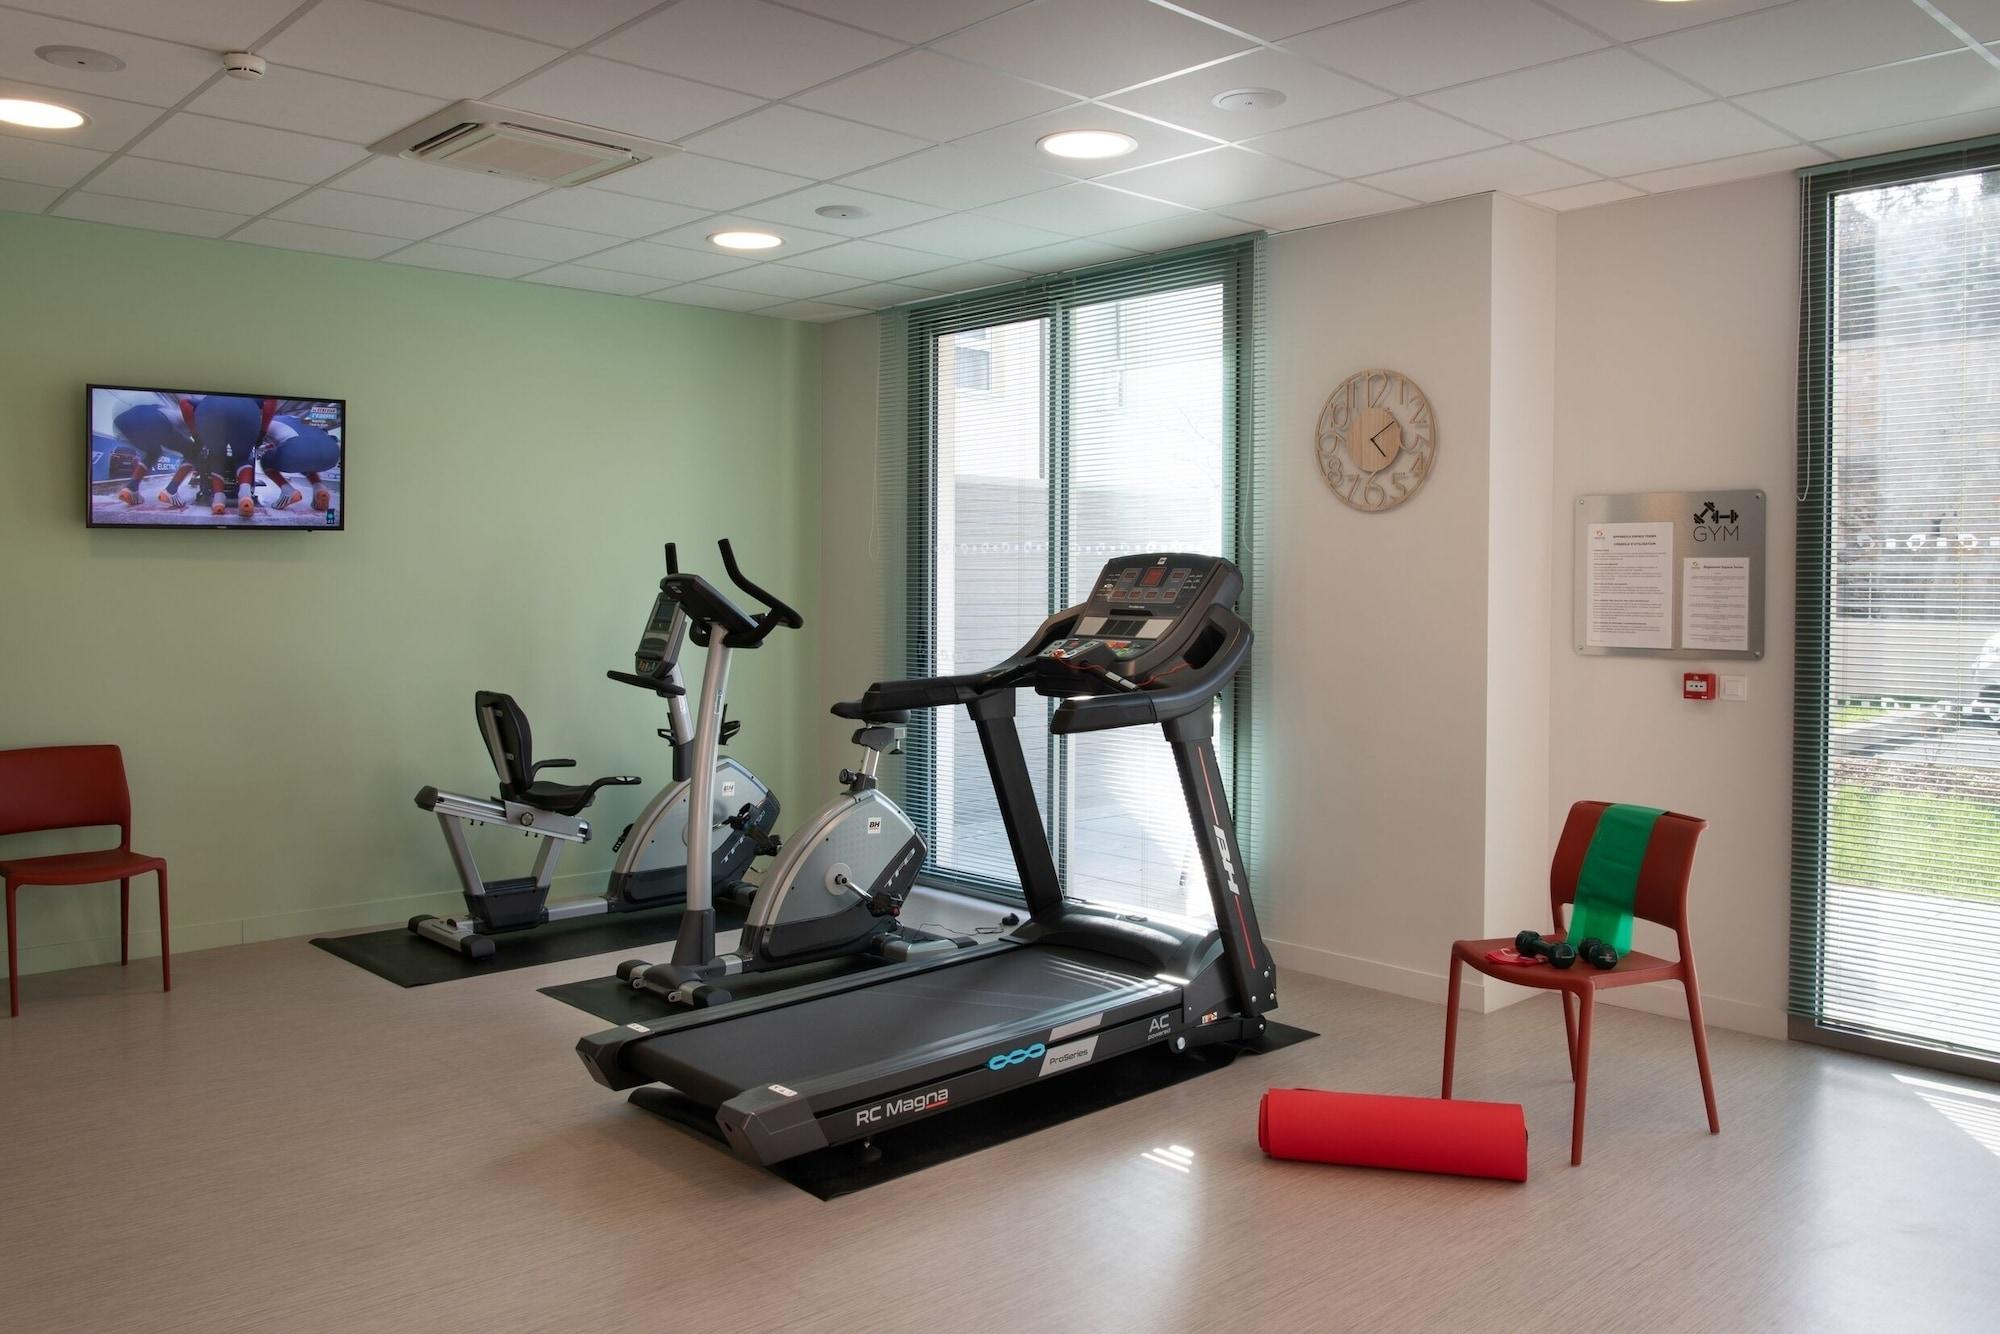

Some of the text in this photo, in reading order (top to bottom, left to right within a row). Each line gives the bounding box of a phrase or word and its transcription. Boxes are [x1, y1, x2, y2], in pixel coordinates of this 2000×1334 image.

[1366, 371, 1389, 409] 12
[1408, 394, 1428, 425] 2
[1327, 457, 1343, 487] 8
[1343, 473, 1360, 501] 7
[1363, 470, 1386, 507] 6
[1693, 525, 1739, 543] GYM
[869, 820, 881, 828] BH
[1213, 824, 1240, 895] BH
[1149, 1013, 1170, 1033] AC
[1049, 1048, 1089, 1066] ProSeries
[856, 1088, 949, 1127] RC Magna
